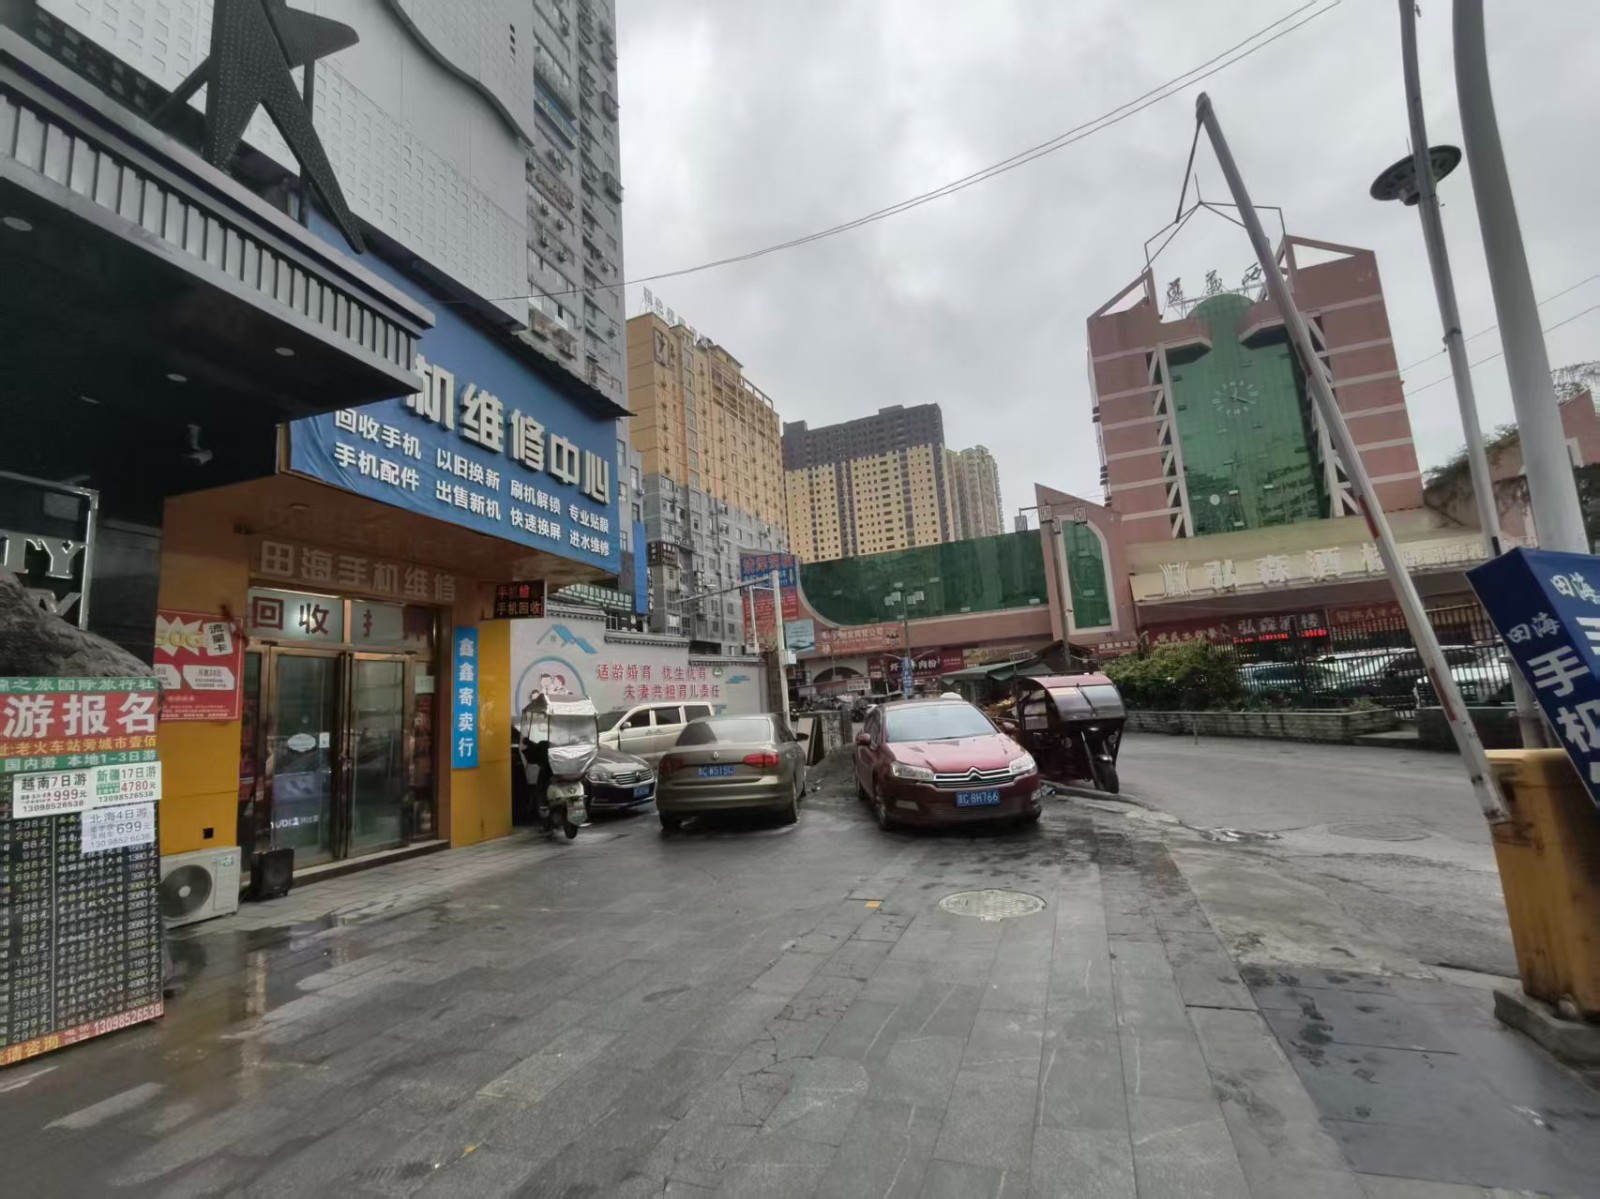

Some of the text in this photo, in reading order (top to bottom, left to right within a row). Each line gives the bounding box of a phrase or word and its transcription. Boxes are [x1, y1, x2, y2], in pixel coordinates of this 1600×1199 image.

[334, 408, 610, 534] 回收手机 以旧换新 刷机解锁 专业贴膜
[334, 441, 611, 556] 手机配件 出售新机 快速换屏 进水维修
[596, 663, 707, 682] 适龄婚育 优生优育
[457, 637, 475, 758] 鑫鑫寄卖行
[624, 684, 721, 701] 夫妻共担育儿责任
[3, 692, 156, 739] 游报名
[4, 757, 57, 772] 国内游
[21, 773, 88, 792] 越南7日游
[94, 1003, 161, 1035] 13098526538
